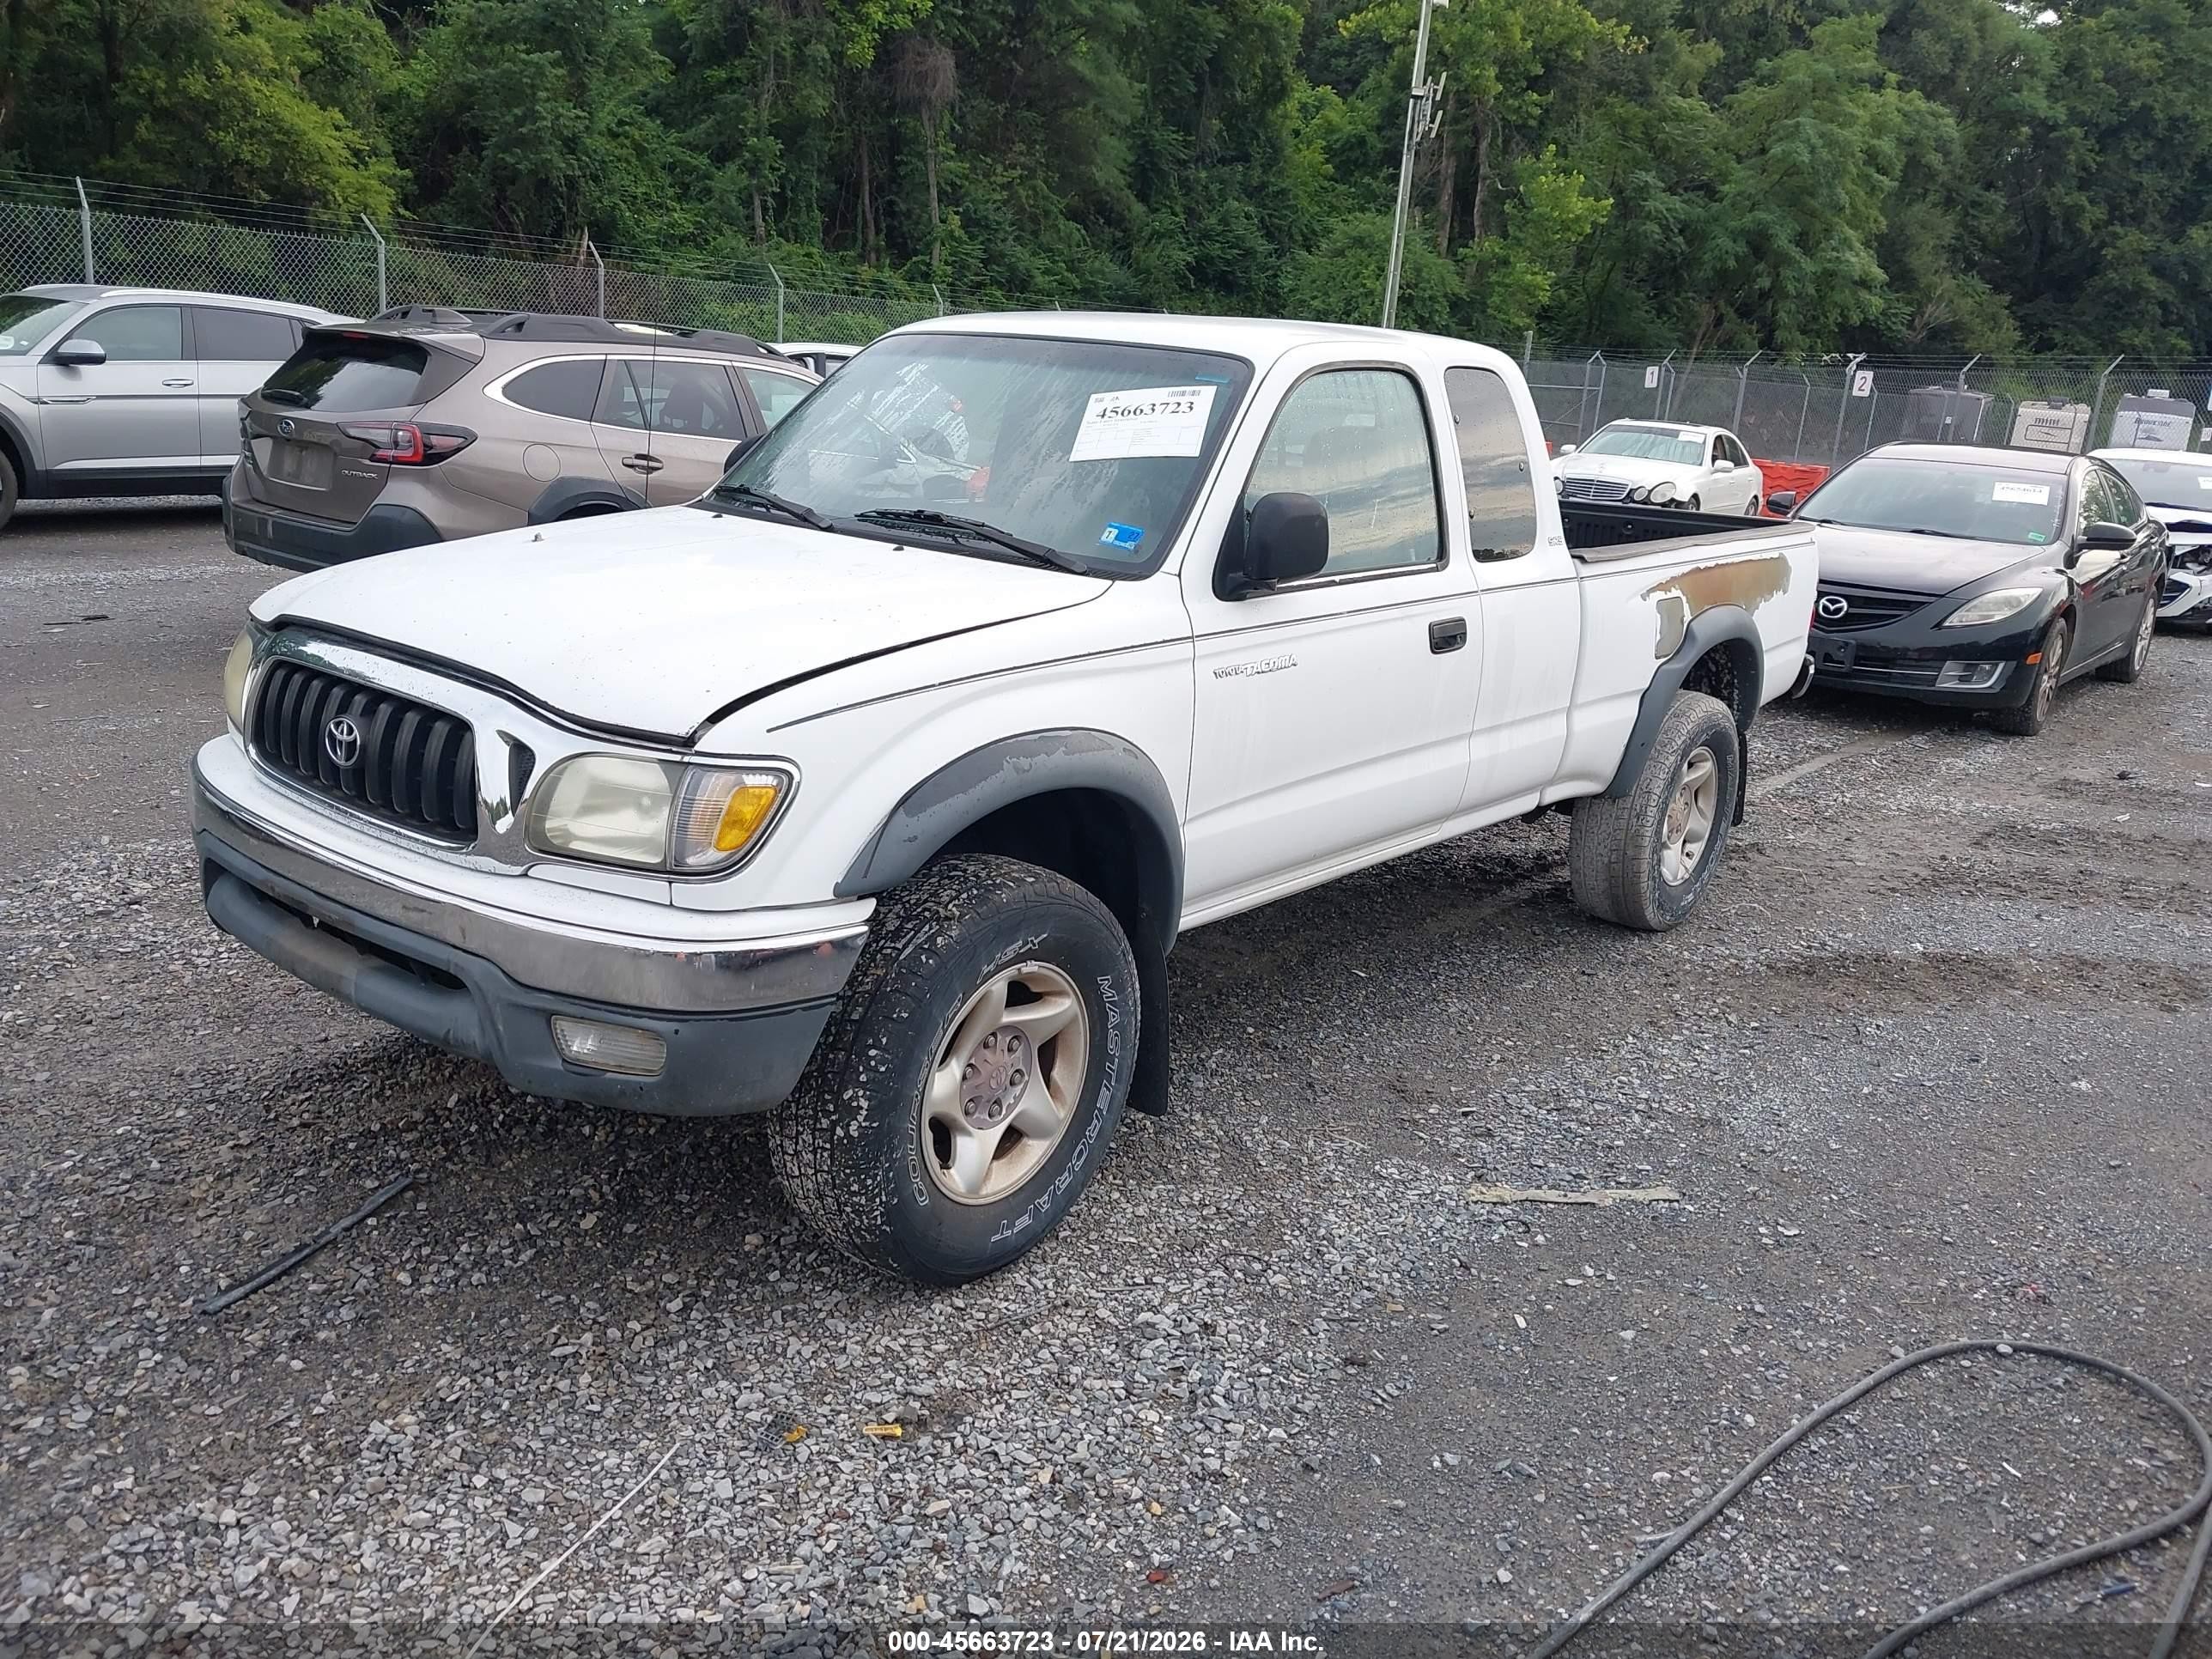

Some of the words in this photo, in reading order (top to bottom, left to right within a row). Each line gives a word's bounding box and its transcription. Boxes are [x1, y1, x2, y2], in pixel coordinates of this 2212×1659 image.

[1649, 371, 1655, 385] 1
[1857, 376, 1868, 392] 2
[1095, 401, 1195, 419] 45663723
[341, 469, 379, 480] OUTBACK
[1212, 665, 1244, 679] TOYOTA
[1243, 653, 1298, 677] TACOMA
[907, 993, 963, 1207] COURSER
[990, 975, 1121, 1243] MASTERCRAFT
